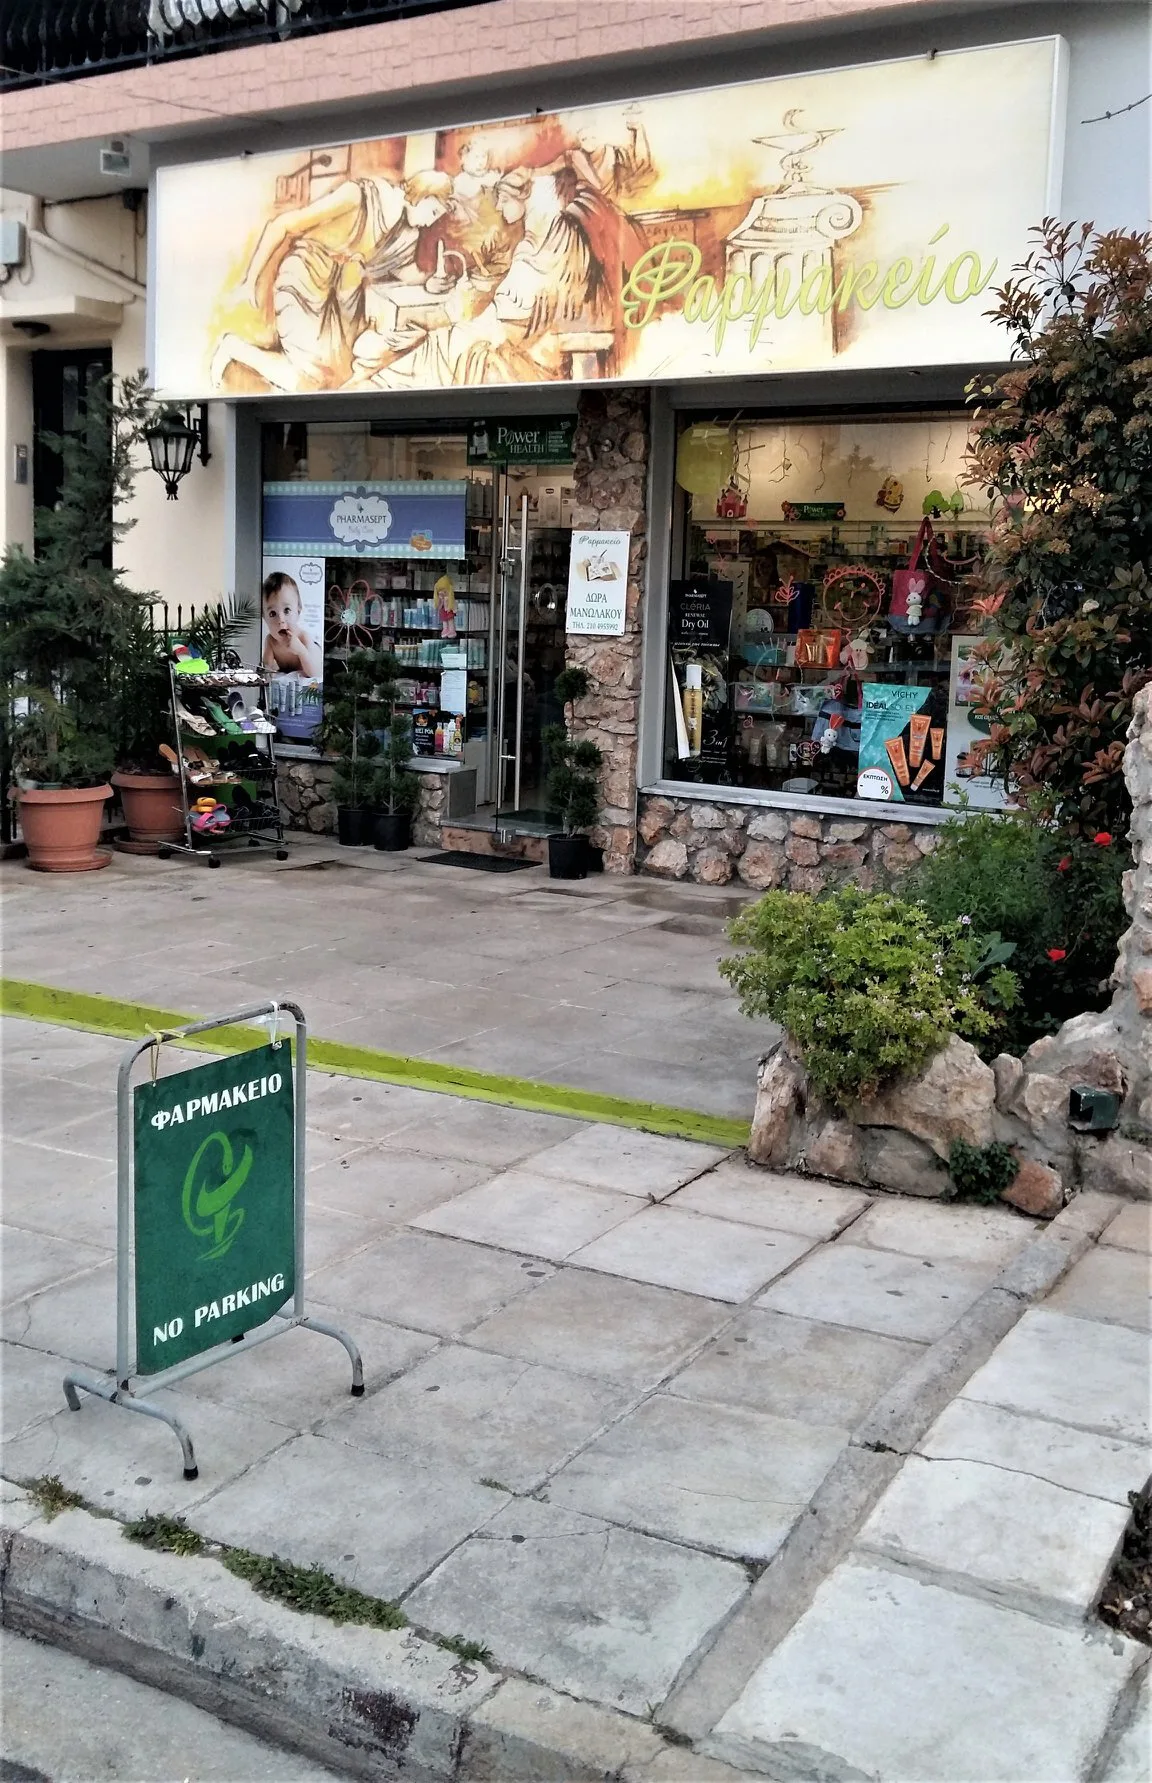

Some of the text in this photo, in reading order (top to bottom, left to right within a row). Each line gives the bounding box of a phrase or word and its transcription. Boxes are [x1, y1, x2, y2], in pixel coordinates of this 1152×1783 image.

[621, 223, 998, 357] Φαρμακείο
[497, 426, 540, 446] Power
[510, 444, 544, 454] HEALTH
[336, 515, 387, 524] PHARMASEPT
[585, 592, 607, 603] ΔΩΡΑ
[570, 607, 622, 619] ΜΑΝΩΛΑΚΟΥ
[681, 619, 709, 630] Dry Oil
[892, 690, 918, 699] VICHY
[881, 785, 889, 795] %
[151, 1073, 282, 1131] ΦΑΡΜΑΚΕΙΟ
[153, 1273, 285, 1346] NO PARKING
